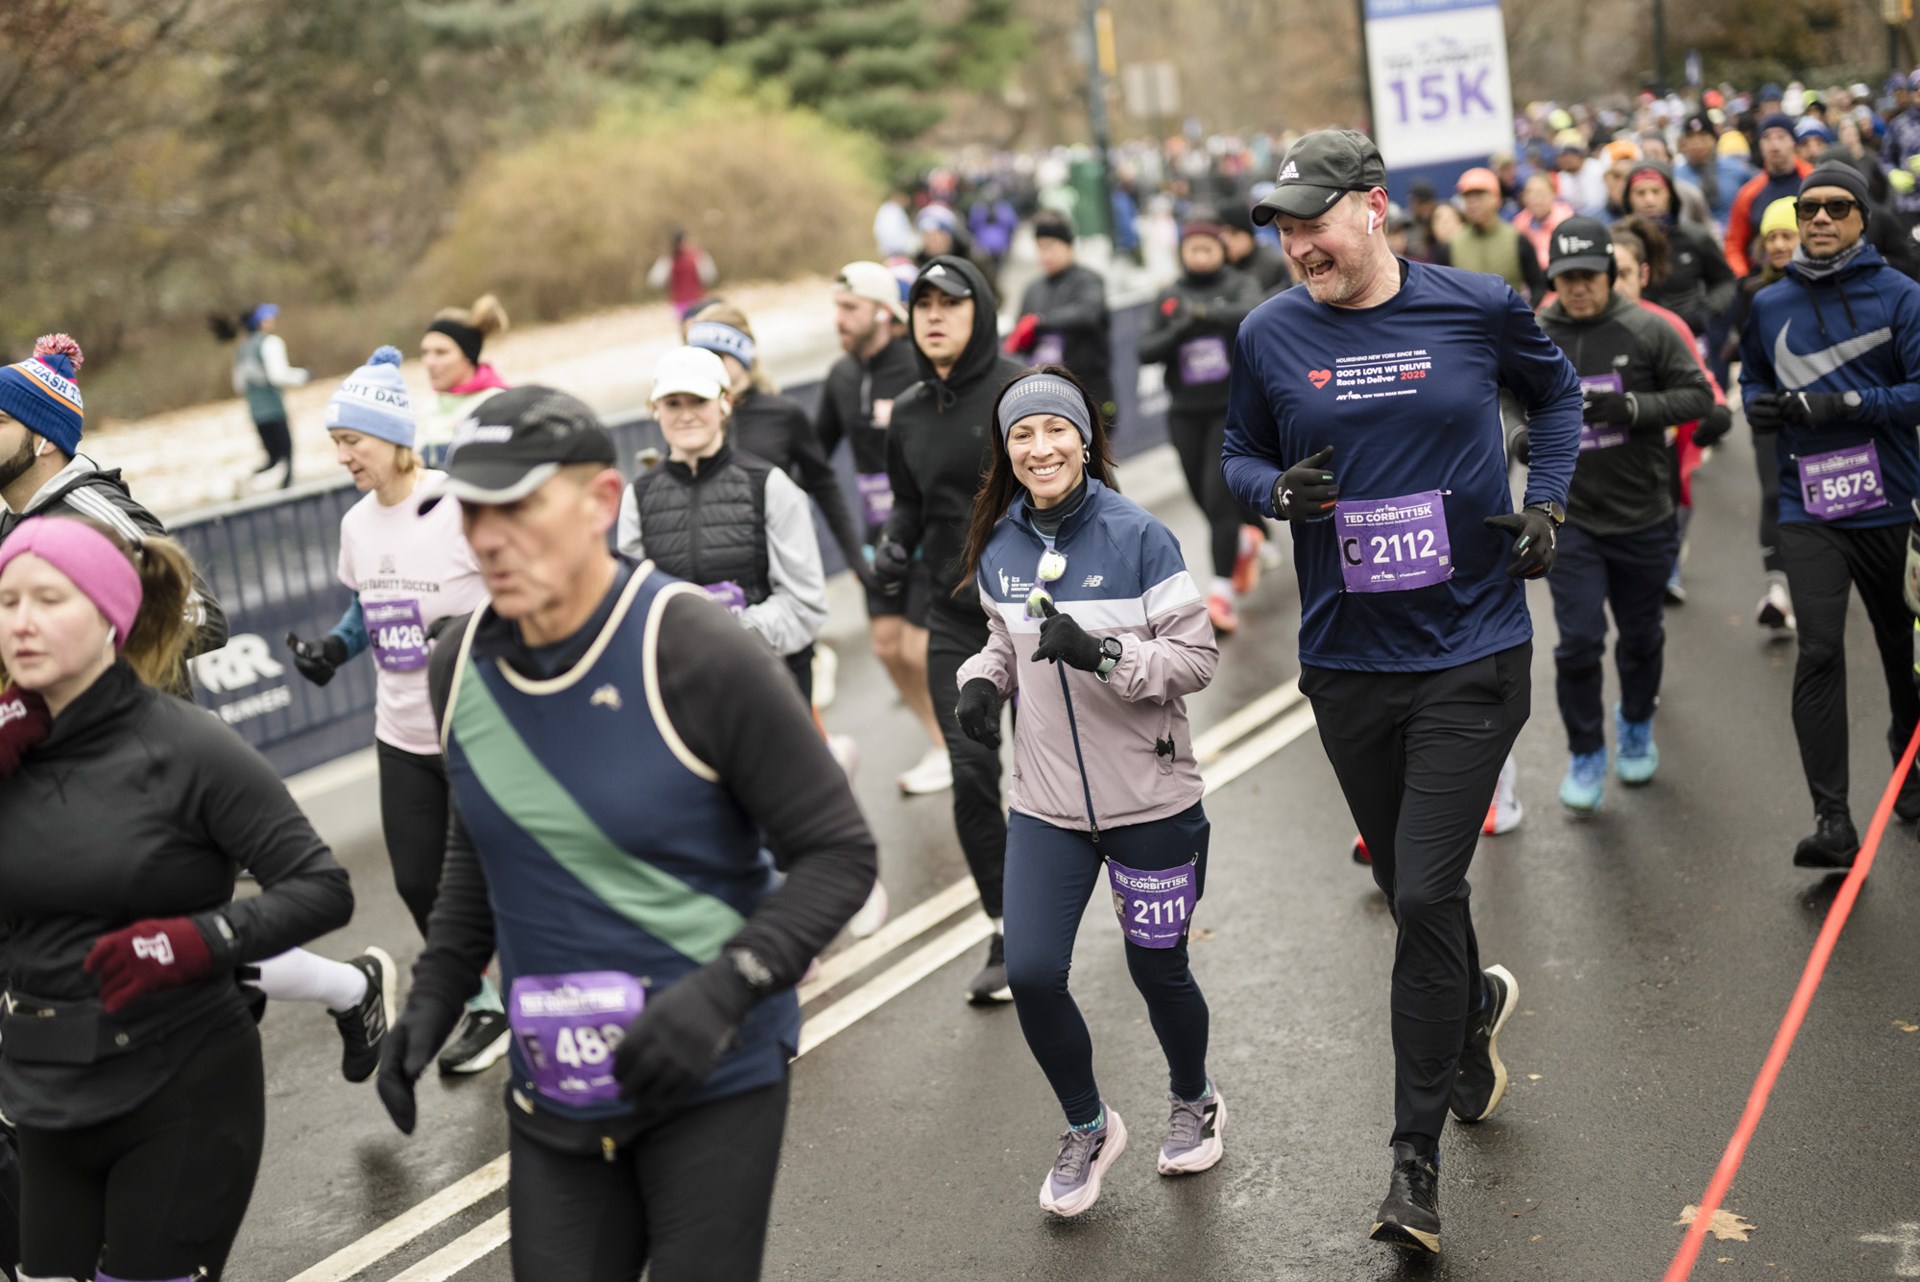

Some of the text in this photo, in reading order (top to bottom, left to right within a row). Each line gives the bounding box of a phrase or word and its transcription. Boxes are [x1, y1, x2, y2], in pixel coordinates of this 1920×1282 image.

[1389, 66, 1495, 123] 15K
[33, 366, 68, 394] DASH
[1336, 369, 1361, 377] GOD'S
[1399, 362, 1431, 371] DELIVER
[1367, 375, 1396, 383] Deliver
[1400, 371, 1426, 380] 2025
[1822, 470, 1877, 500] 5673
[1344, 515, 1364, 523] TED
[1343, 529, 1437, 566] C 2112
[402, 580, 440, 593] SOCCER
[1115, 873, 1128, 884] TED
[1133, 896, 1186, 925] 2111
